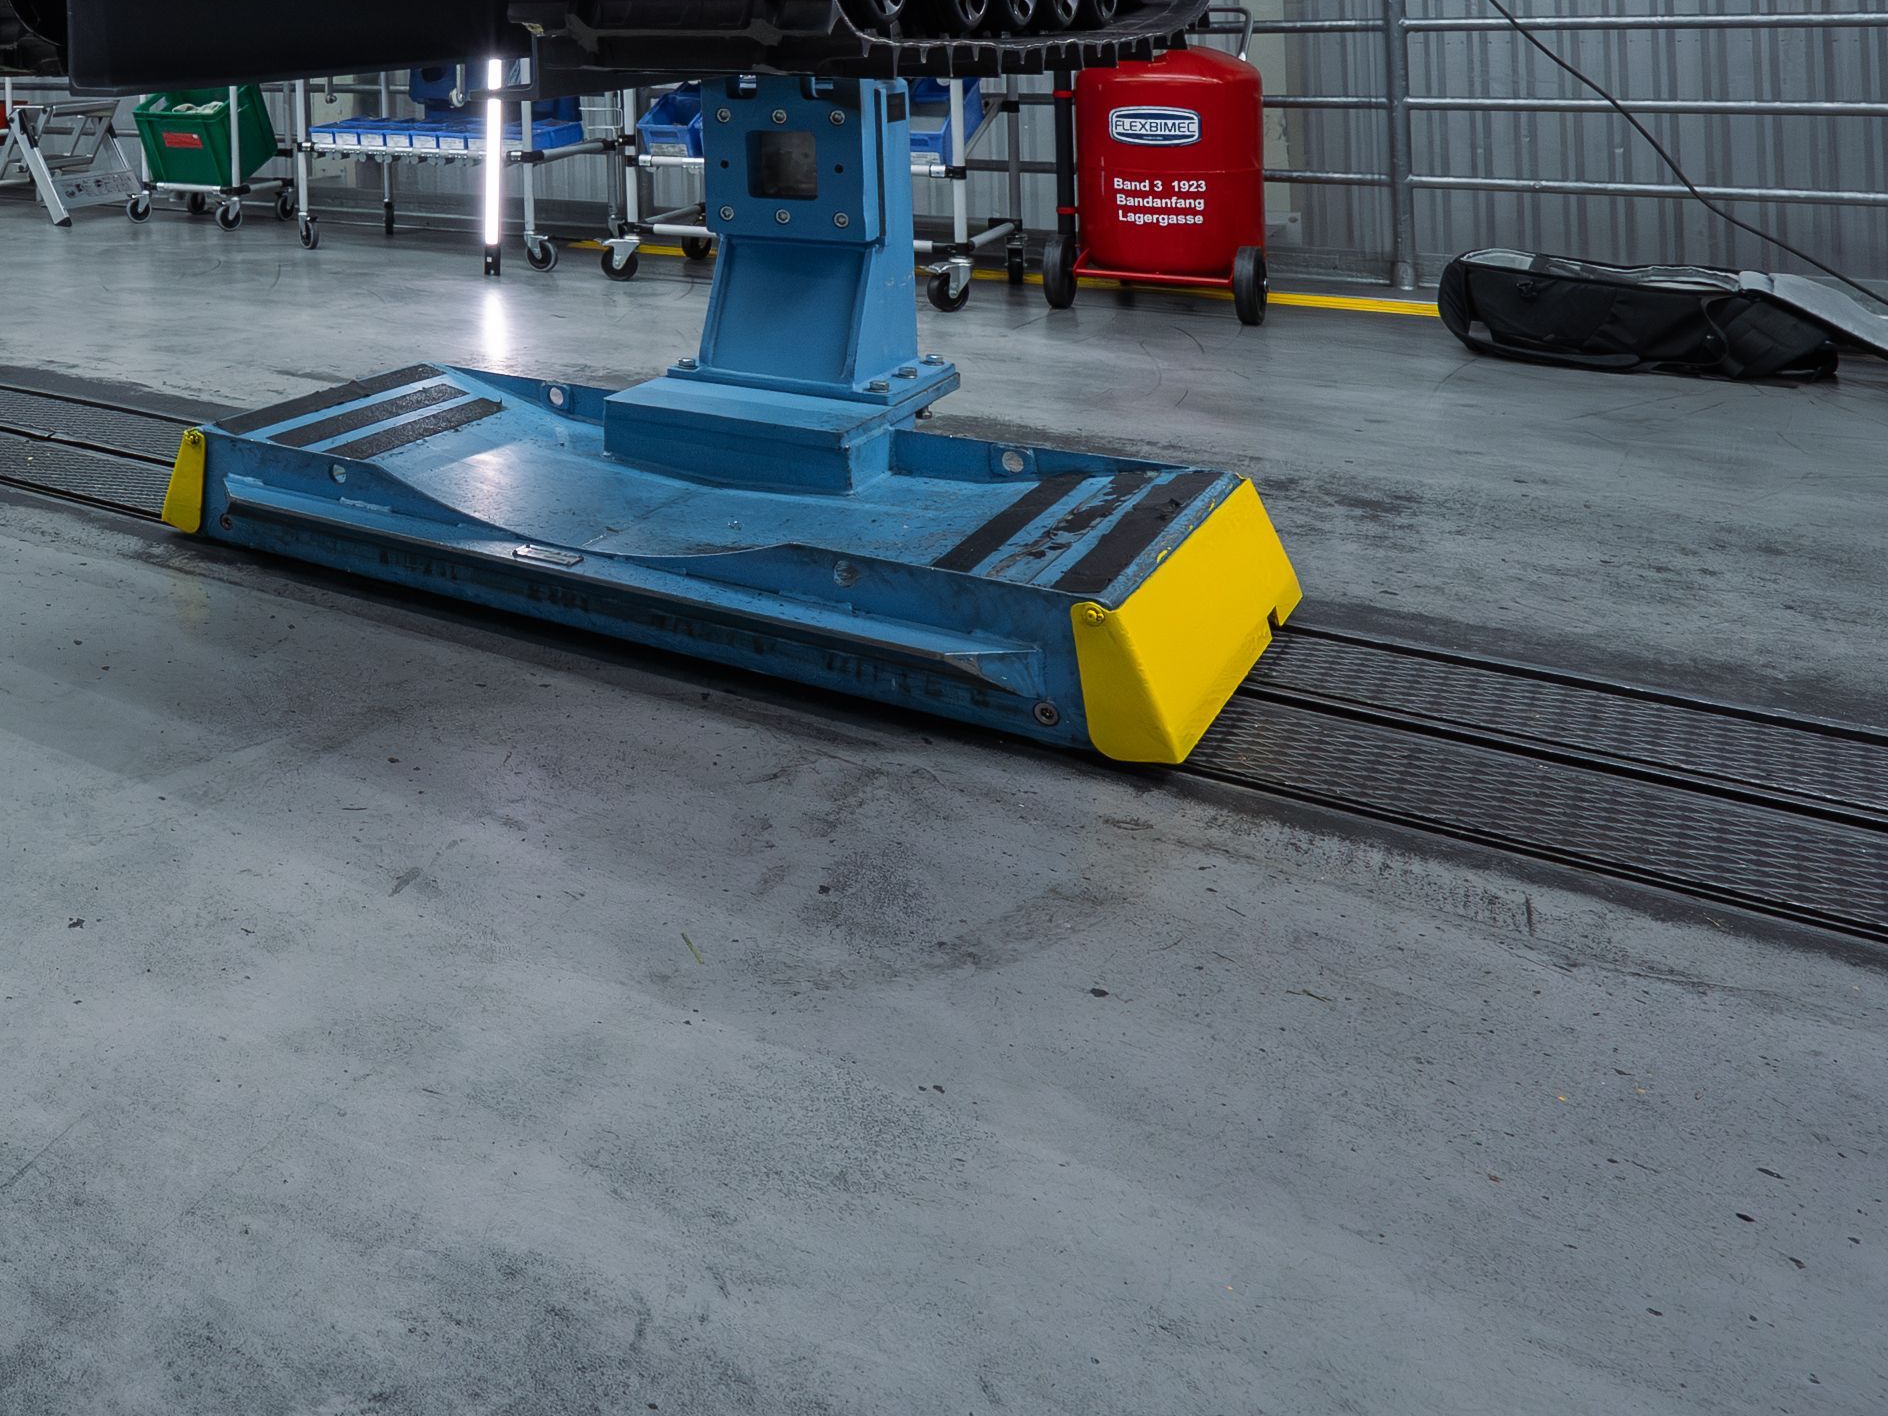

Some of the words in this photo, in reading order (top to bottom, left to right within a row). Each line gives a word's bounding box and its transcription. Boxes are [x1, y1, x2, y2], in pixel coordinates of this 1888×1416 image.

[1115, 120, 1197, 133] FLEXBIMEC
[1114, 178, 1150, 191] Band
[1154, 180, 1162, 191] 3
[1172, 180, 1206, 192] 1923
[1116, 194, 1205, 210] Bandanfang
[1118, 210, 1203, 226] Lagergasse
